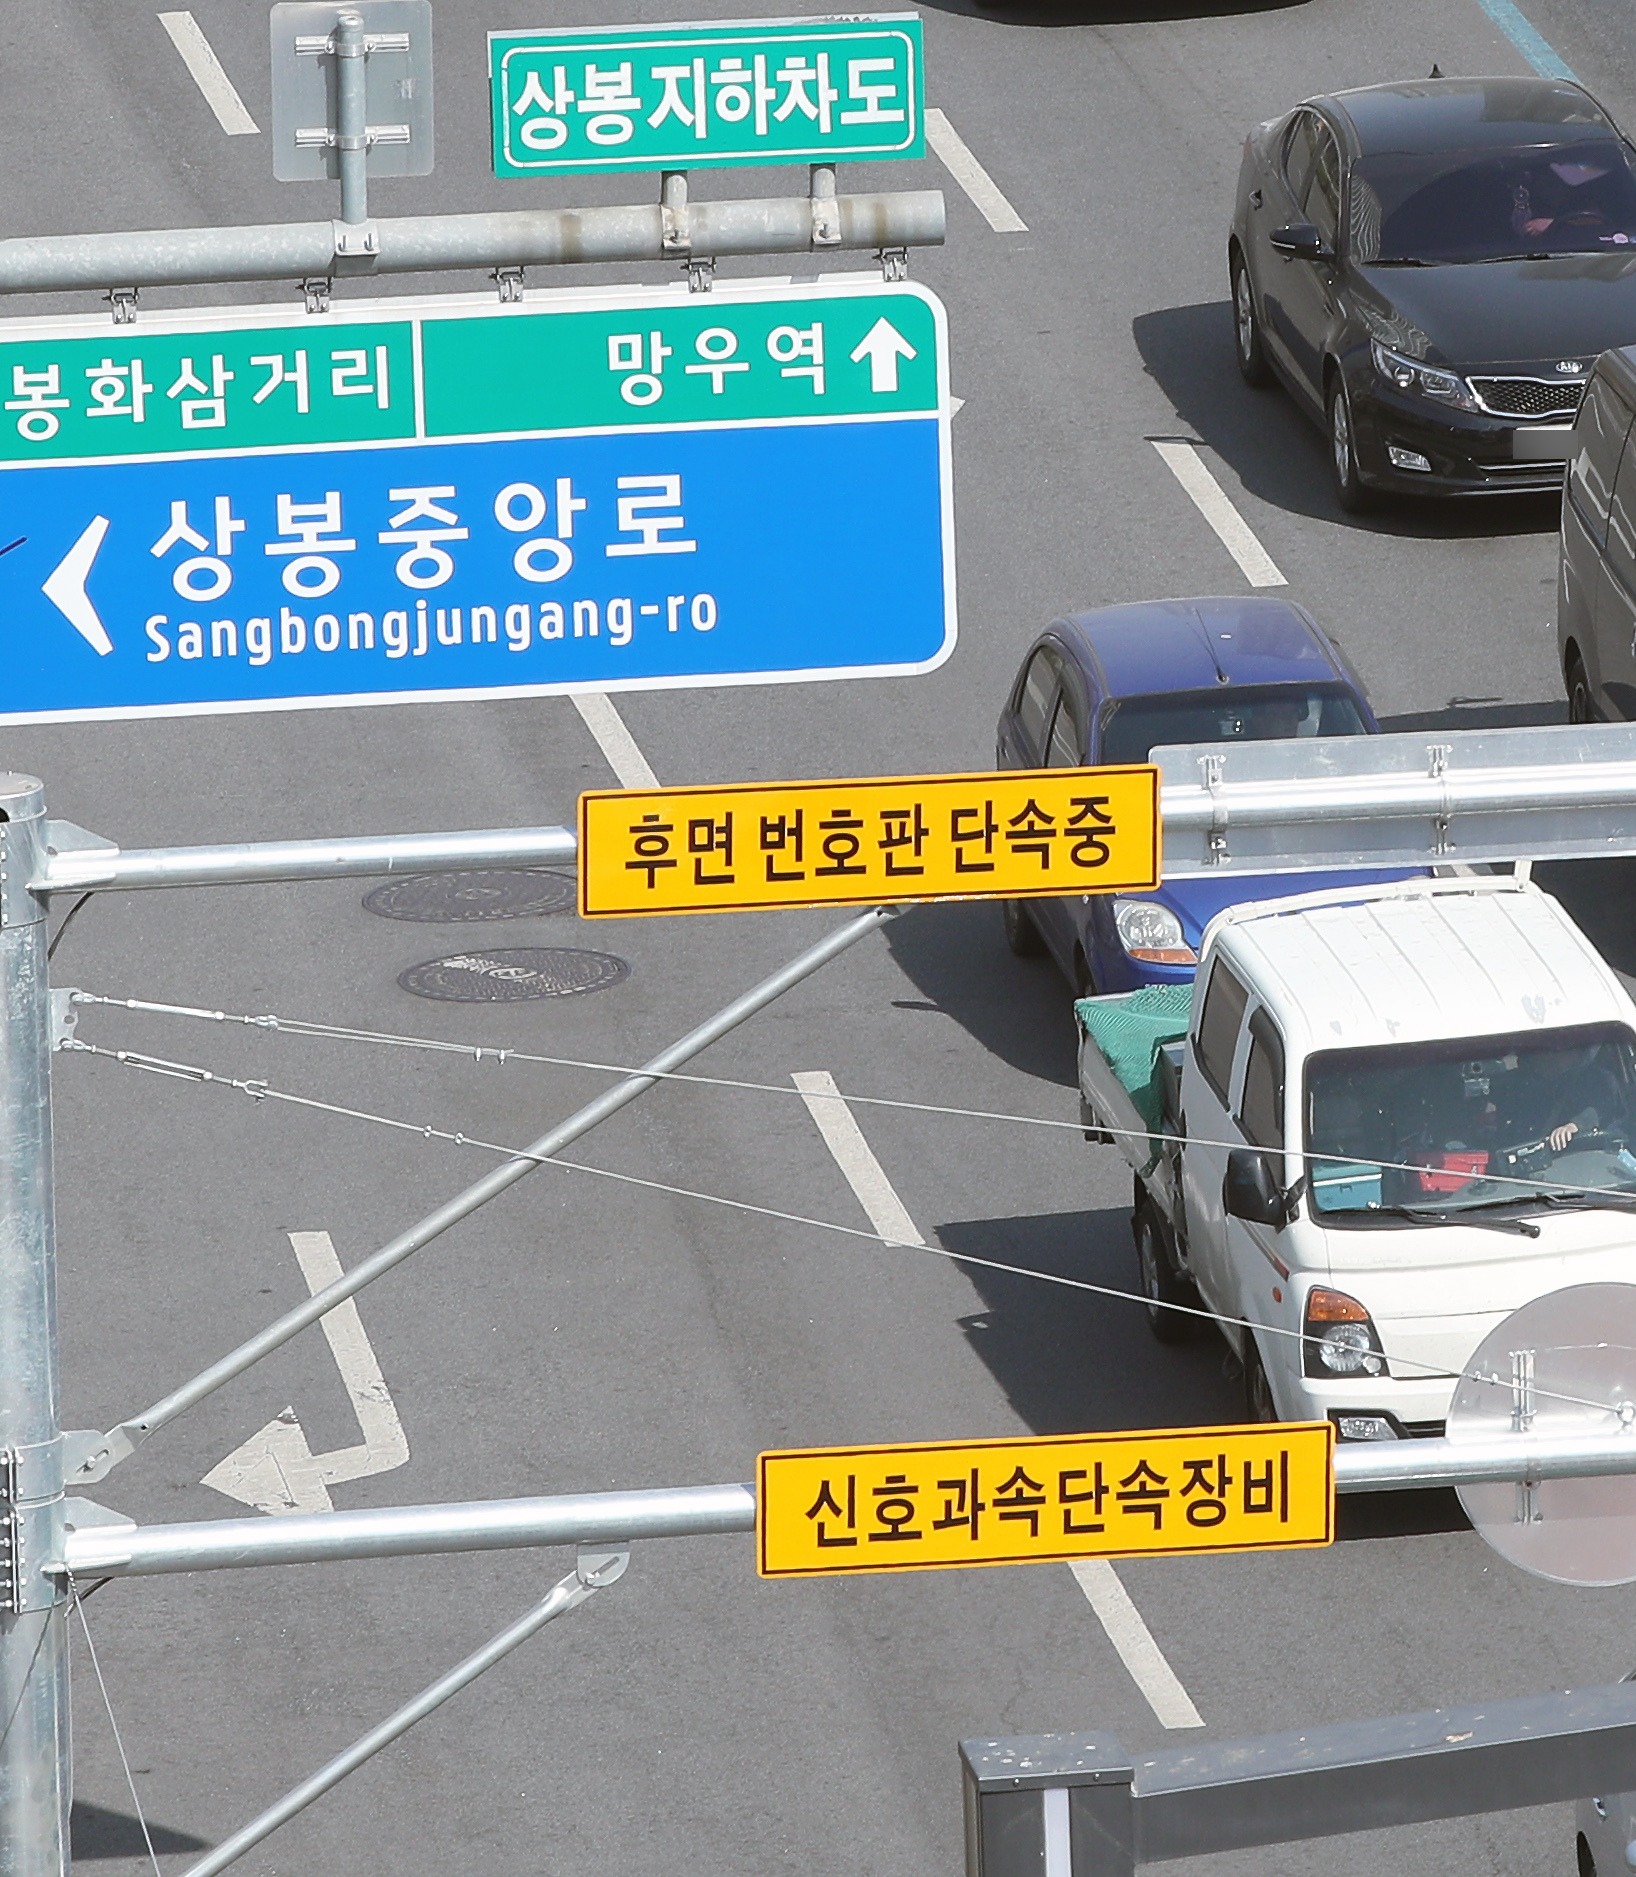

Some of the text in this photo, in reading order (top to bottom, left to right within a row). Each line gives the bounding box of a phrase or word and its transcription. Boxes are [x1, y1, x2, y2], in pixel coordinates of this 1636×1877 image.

[513, 53, 904, 149] 상봉지하차도
[4, 346, 388, 441] 봉화삼거리
[609, 323, 824, 405] 망우역
[151, 475, 696, 601] 상봉중앙로
[146, 592, 717, 665] Sangbongjungang-ro
[626, 797, 1115, 888] 후면 번호판 단속중
[806, 1454, 1287, 1547] 신호과속단속장비
